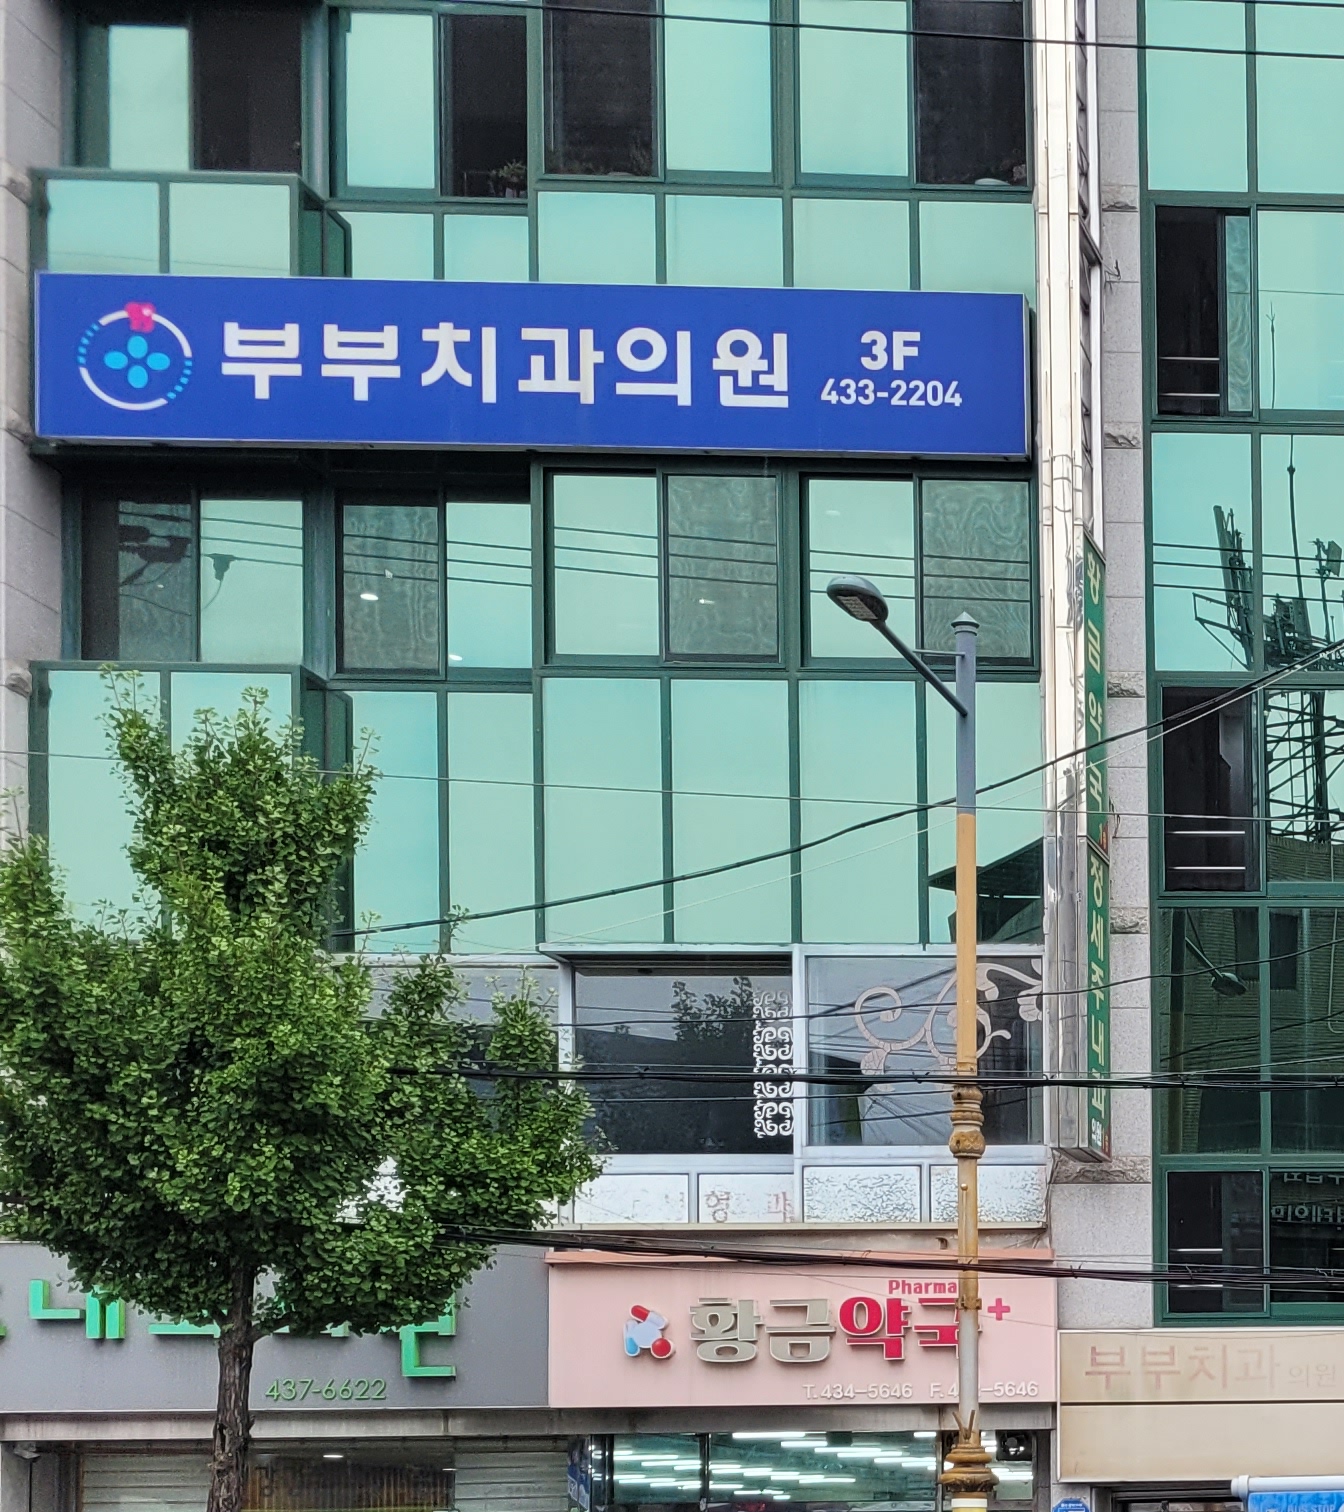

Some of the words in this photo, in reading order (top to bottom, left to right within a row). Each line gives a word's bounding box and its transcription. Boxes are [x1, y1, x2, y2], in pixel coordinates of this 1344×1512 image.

[221, 321, 790, 409] 부부치과의원
[860, 330, 921, 371] 3F
[820, 376, 962, 408] 433-2204
[689, 1296, 983, 1364] 황금약국
[1084, 1343, 1280, 1392] 부부치과
[265, 1378, 388, 1401] 437-6622
[929, 1381, 1040, 1399] F.4-5646
